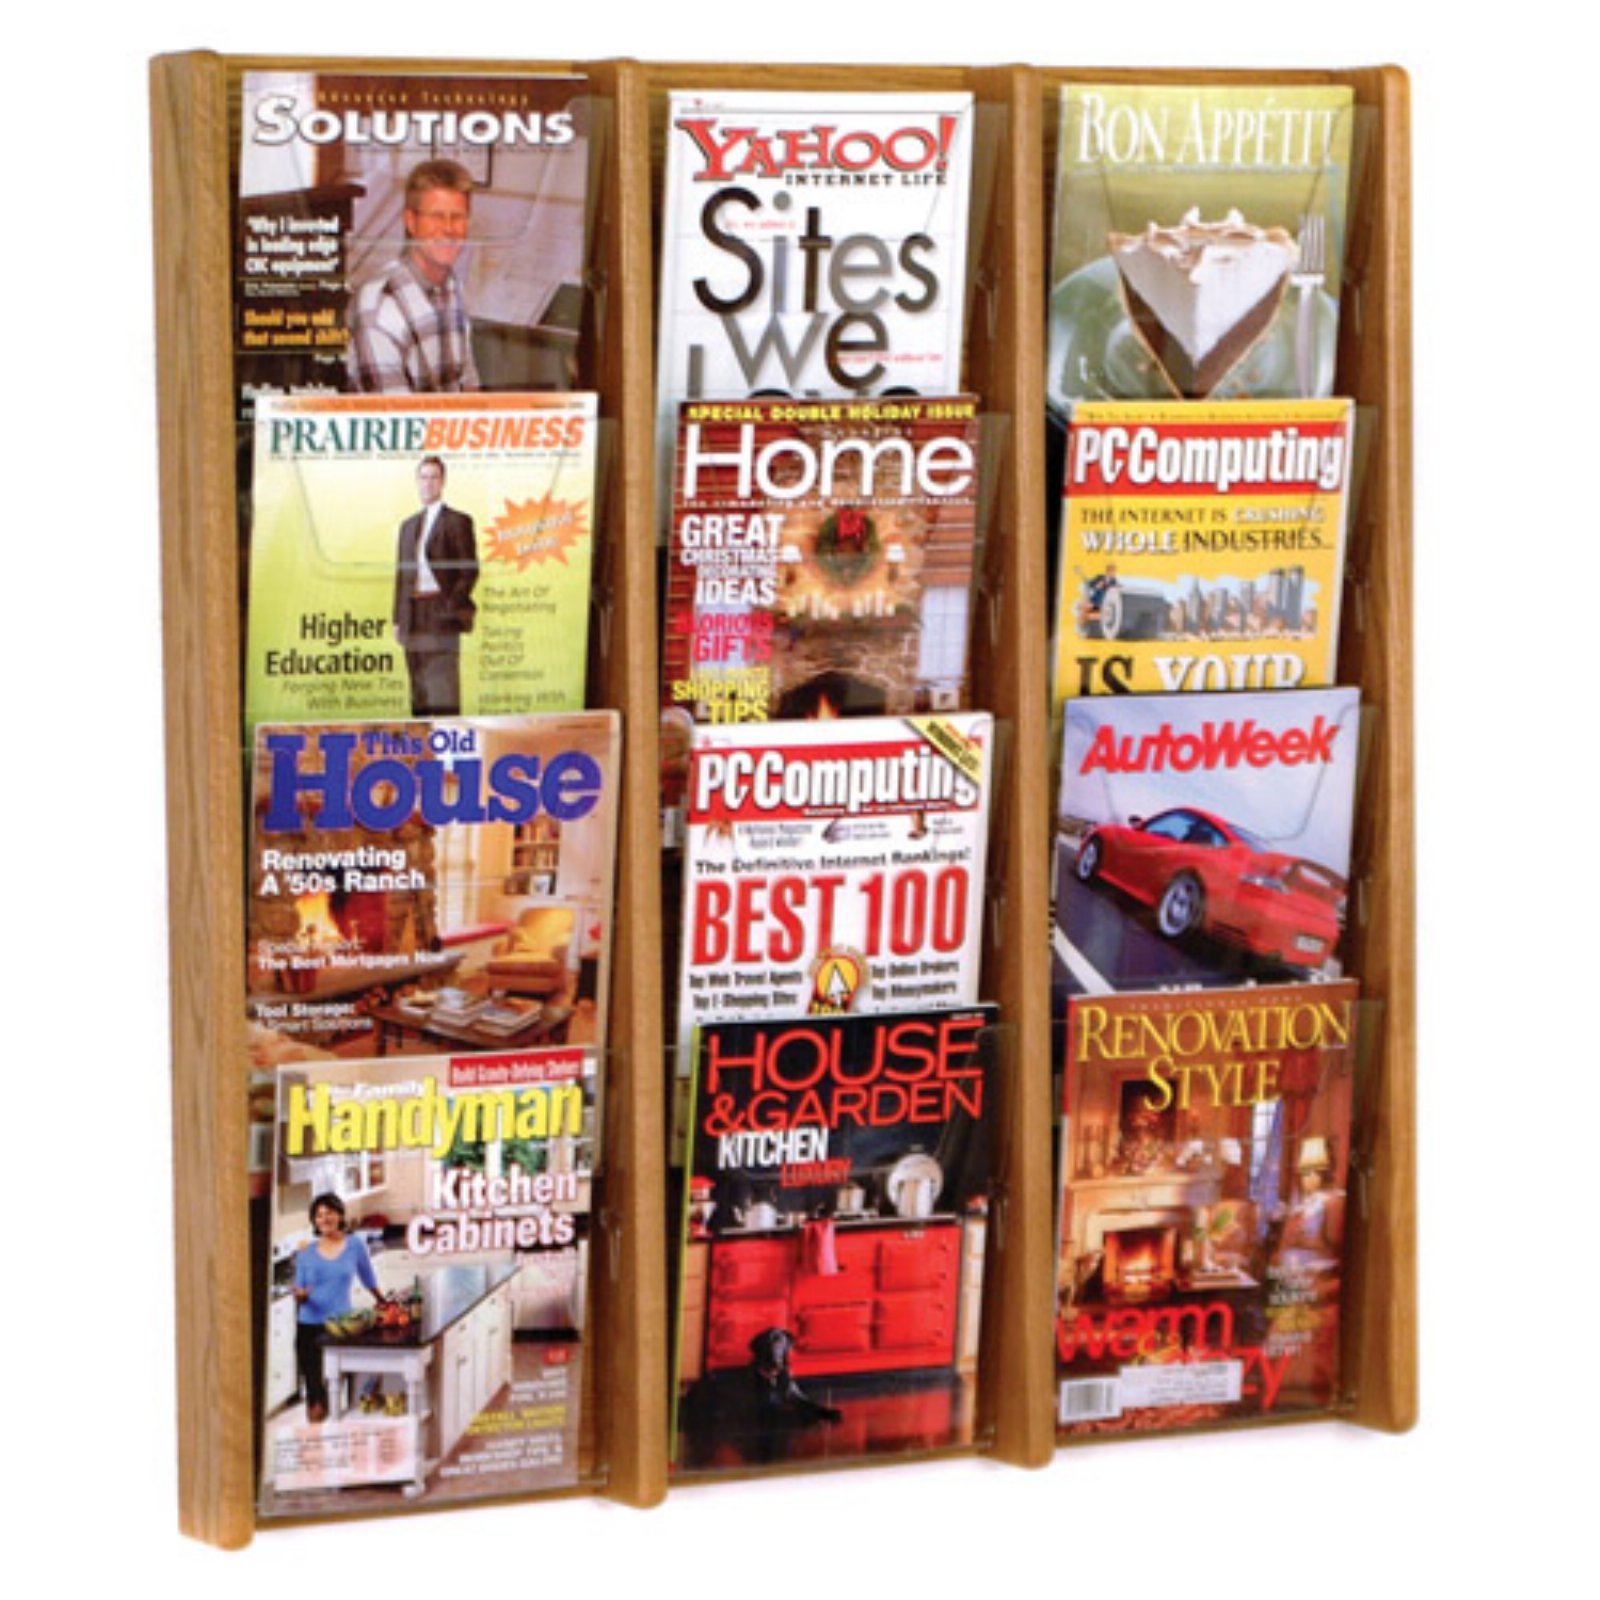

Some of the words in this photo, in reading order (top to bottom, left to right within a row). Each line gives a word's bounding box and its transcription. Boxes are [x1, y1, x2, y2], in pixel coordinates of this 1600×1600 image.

[253, 95, 576, 145] SOLUTIONS
[1076, 91, 1168, 164] BON
[675, 115, 957, 182] YAHOO!
[786, 174, 894, 187] INTERNET
[901, 173, 948, 186] LIFE
[692, 186, 940, 314] Sites
[720, 311, 890, 391] we
[688, 407, 763, 422] SPECIAL
[770, 405, 842, 421] DOUBLE
[849, 405, 921, 420] HOLIDAY
[926, 403, 976, 419] ISSUE
[683, 423, 976, 498] Home
[681, 514, 786, 548] GREAT
[1081, 508, 1114, 525] THE
[1118, 507, 1206, 524] INTERNET
[1211, 508, 1228, 523] IS
[1081, 530, 1179, 555] WHOLE
[696, 578, 778, 606] IDEAS
[300, 613, 388, 646] Higher
[692, 634, 774, 663] GIFTS
[265, 650, 394, 677] Education
[708, 701, 769, 725] TIPS
[361, 731, 424, 757] This
[428, 728, 479, 754] Old
[1078, 716, 1342, 776] AutoWeek
[263, 733, 603, 832] House
[261, 847, 408, 872] Renovating
[696, 859, 727, 874] The
[732, 857, 814, 873] Definitive
[820, 854, 887, 870] Internet
[259, 873, 281, 896] A
[343, 868, 427, 893] Ranch
[691, 874, 846, 966] BEST
[860, 866, 970, 956] 100
[1076, 1001, 1350, 1062] RENOVATION
[707, 1018, 986, 1094] HOUSE
[1144, 1055, 1282, 1111] STYLE
[287, 1076, 584, 1159] Handyman
[718, 1127, 829, 1170] KITCHEN
[432, 1165, 578, 1210] Kitchen
[407, 1212, 576, 1255] Cabinets
[1056, 1302, 1234, 1363] warm
